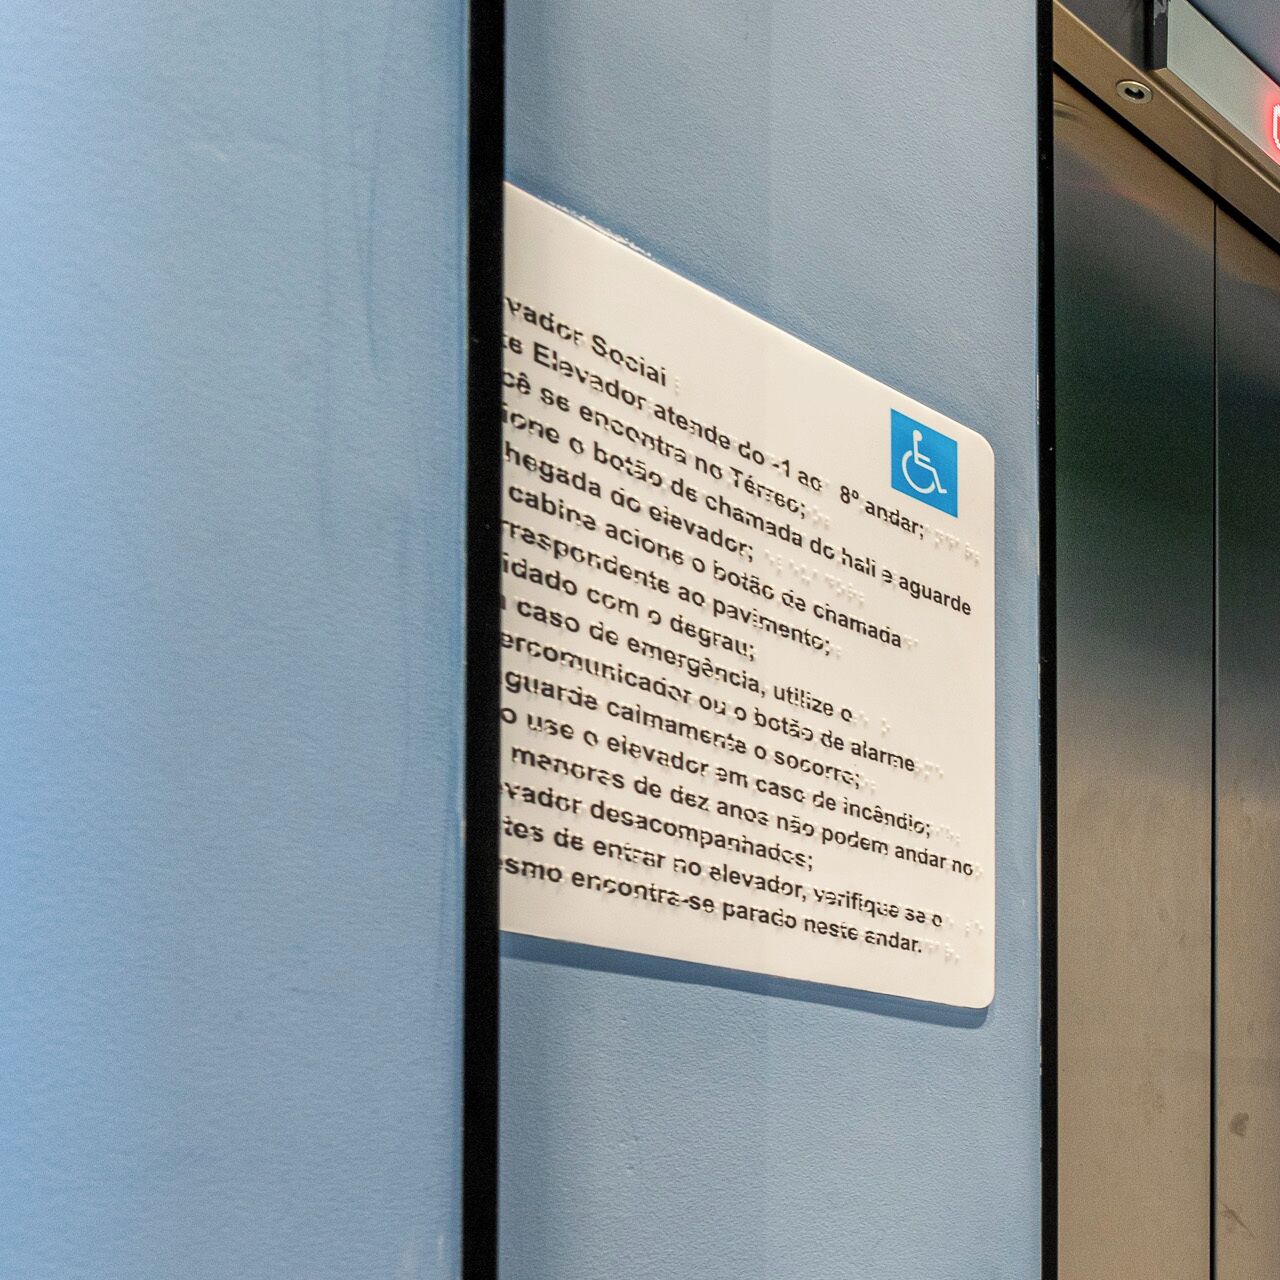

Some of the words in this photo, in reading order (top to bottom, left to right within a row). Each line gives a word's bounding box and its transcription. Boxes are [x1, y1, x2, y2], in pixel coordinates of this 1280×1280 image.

[591, 334, 666, 387] Social
[533, 341, 647, 411] Elevador
[653, 403, 731, 450] atende
[738, 440, 766, 466] do
[771, 459, 790, 478] -1
[797, 470, 823, 492] ao
[864, 500, 924, 541] andar;
[540, 387, 570, 413] se
[579, 405, 687, 465] encontra
[694, 455, 723, 480] no
[730, 466, 806, 520] Térreo;
[508, 486, 597, 531] cabine
[605, 523, 685, 566] acione
[691, 557, 706, 574] o
[713, 559, 775, 600] botão
[781, 589, 807, 612] de
[813, 603, 902, 649] chamada
[569, 436, 585, 455] o
[593, 440, 663, 488] botão
[669, 477, 698, 503] de
[705, 495, 803, 548] chamada
[809, 536, 835, 560] do
[841, 547, 876, 578] hall
[881, 569, 893, 584] e
[898, 575, 972, 616] aguarde
[610, 487, 642, 514] do
[648, 505, 753, 563] elevador;
[518, 601, 580, 633] caso
[588, 621, 619, 646] de
[627, 636, 766, 699] emergência,
[773, 685, 834, 717] utilize
[840, 708, 853, 723] o
[586, 588, 639, 619] com
[647, 609, 662, 626] o
[669, 614, 755, 663] degrau;
[677, 585, 706, 608] ao
[712, 598, 830, 657] pavimento;
[505, 671, 598, 711] guarde
[606, 701, 747, 755] calmamente
[753, 745, 767, 760] o
[773, 750, 860, 790] socorro;
[527, 714, 574, 740] use
[583, 730, 599, 747] o
[606, 734, 709, 777] elevador
[714, 767, 749, 789] em
[755, 778, 806, 804] caso
[812, 790, 837, 812] de
[843, 796, 931, 840] incêndio;
[698, 695, 727, 716] ou
[733, 706, 747, 722] o
[754, 706, 814, 742] botão
[819, 729, 845, 751] de
[850, 740, 916, 772] alarme
[500, 782, 583, 815] vador
[590, 799, 813, 872] desacompanhados;
[512, 747, 625, 790] menores
[633, 775, 662, 799] de
[669, 785, 710, 812] dez
[716, 800, 770, 827] anos
[776, 814, 816, 838] não
[821, 826, 889, 856] podem
[894, 845, 948, 869] andar
[951, 859, 974, 876] no
[500, 857, 563, 883] smo
[571, 871, 715, 914] encontra-se
[722, 900, 797, 925] parado
[804, 918, 859, 941] neste
[864, 930, 922, 954] andar.
[553, 827, 584, 852] de
[592, 839, 667, 869] entrar
[673, 857, 702, 877] no
[708, 863, 807, 903] elevador,
[813, 887, 900, 919] verifique
[904, 908, 927, 924] se
[931, 913, 943, 928] o
